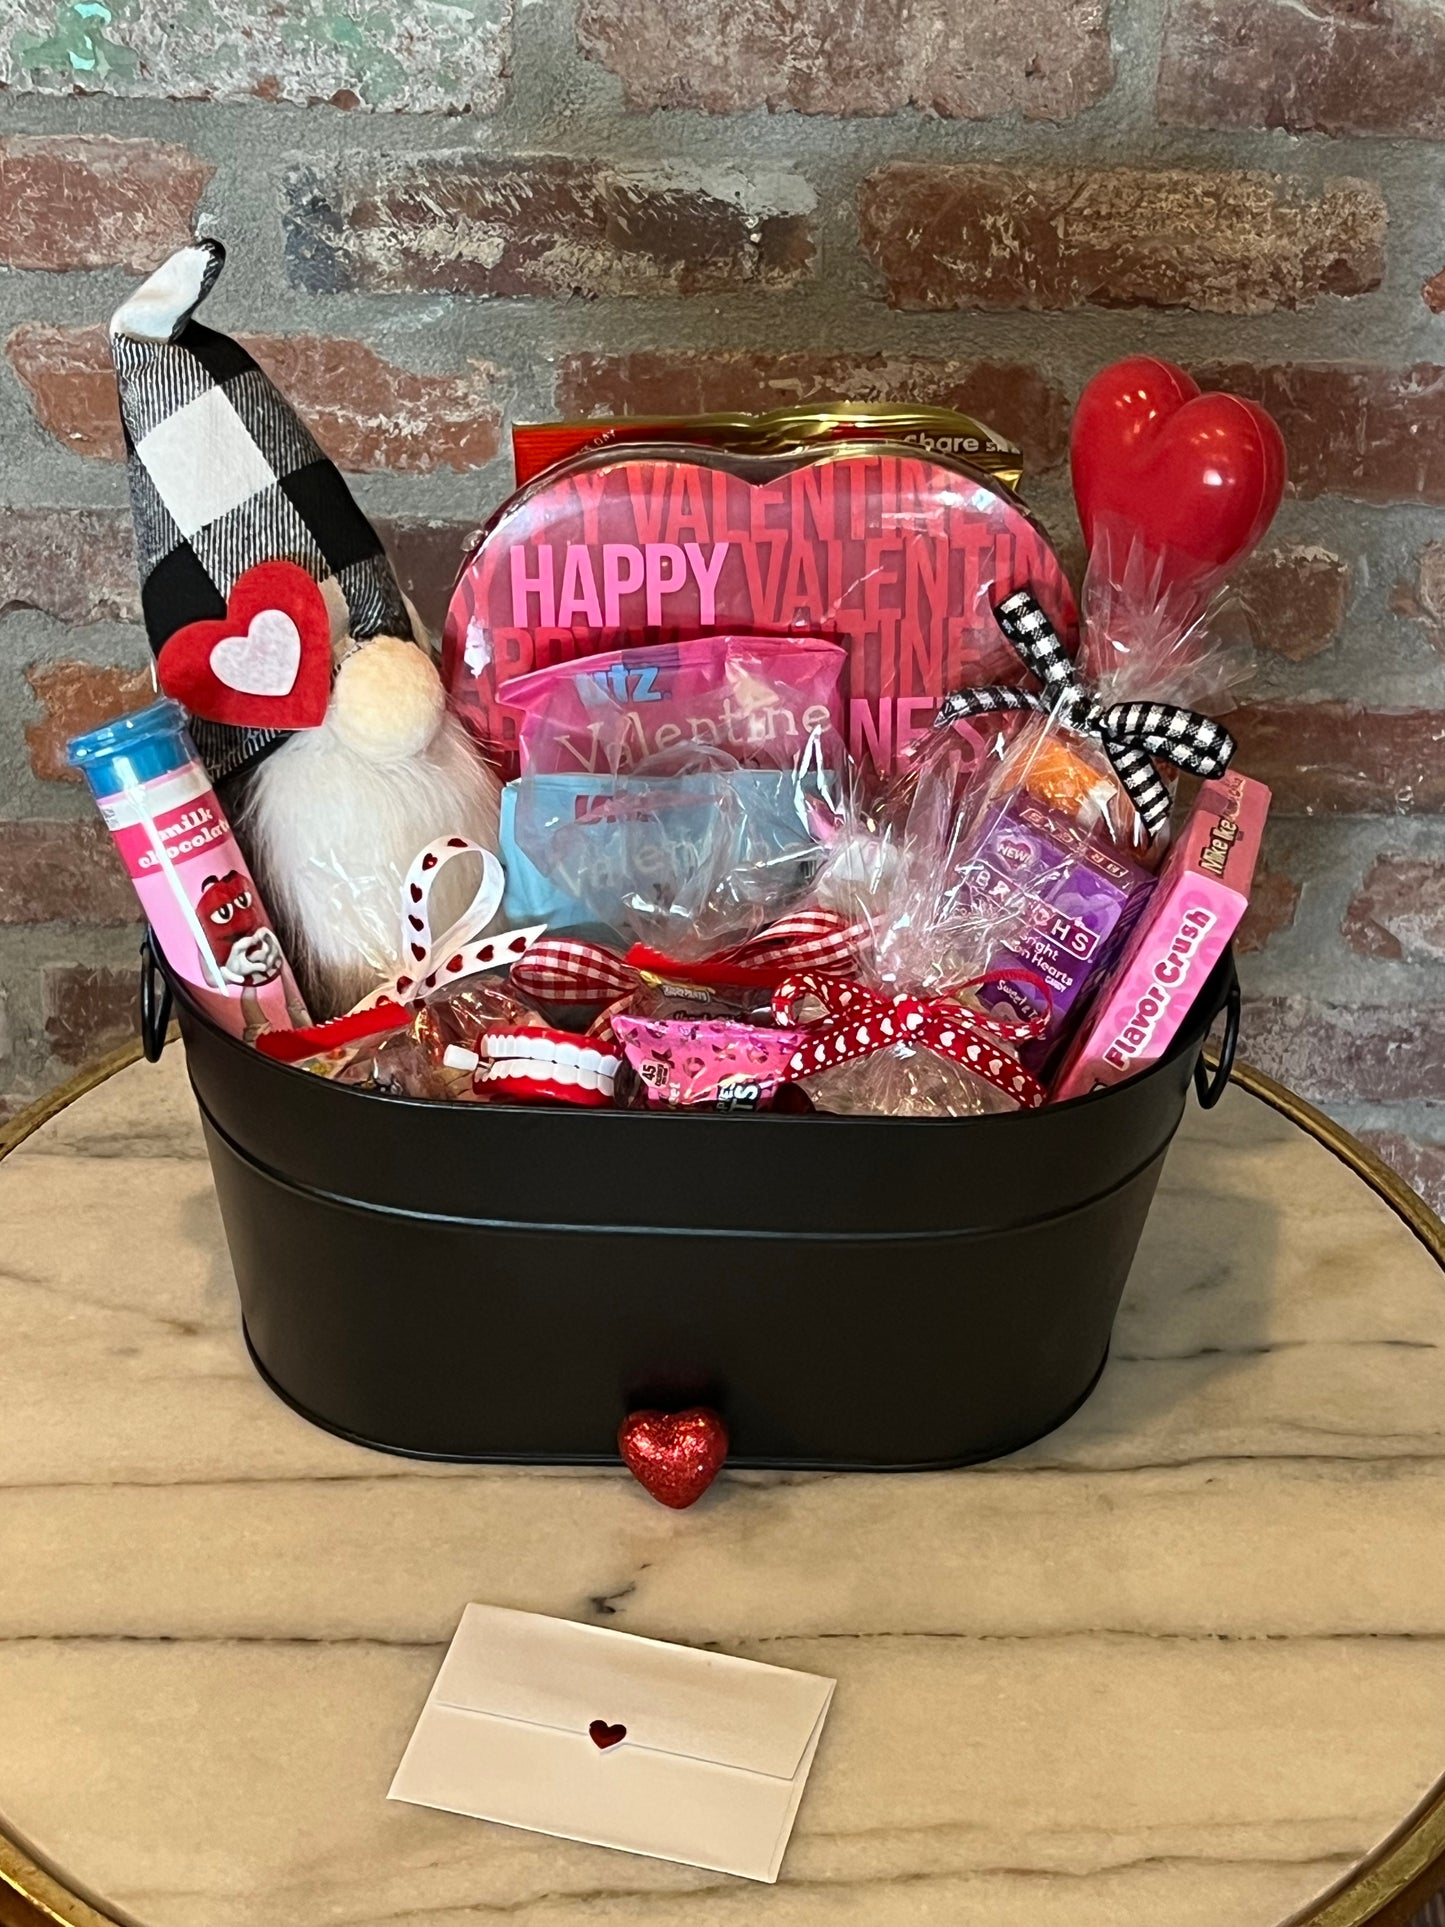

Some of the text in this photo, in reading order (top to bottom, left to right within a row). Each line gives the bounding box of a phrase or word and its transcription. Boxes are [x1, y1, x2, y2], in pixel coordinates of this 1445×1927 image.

[511, 543, 730, 629] HAPPY
[157, 807, 214, 842] milk
[1031, 953, 1074, 986] Hearts
[642, 1064, 656, 1081] 45
